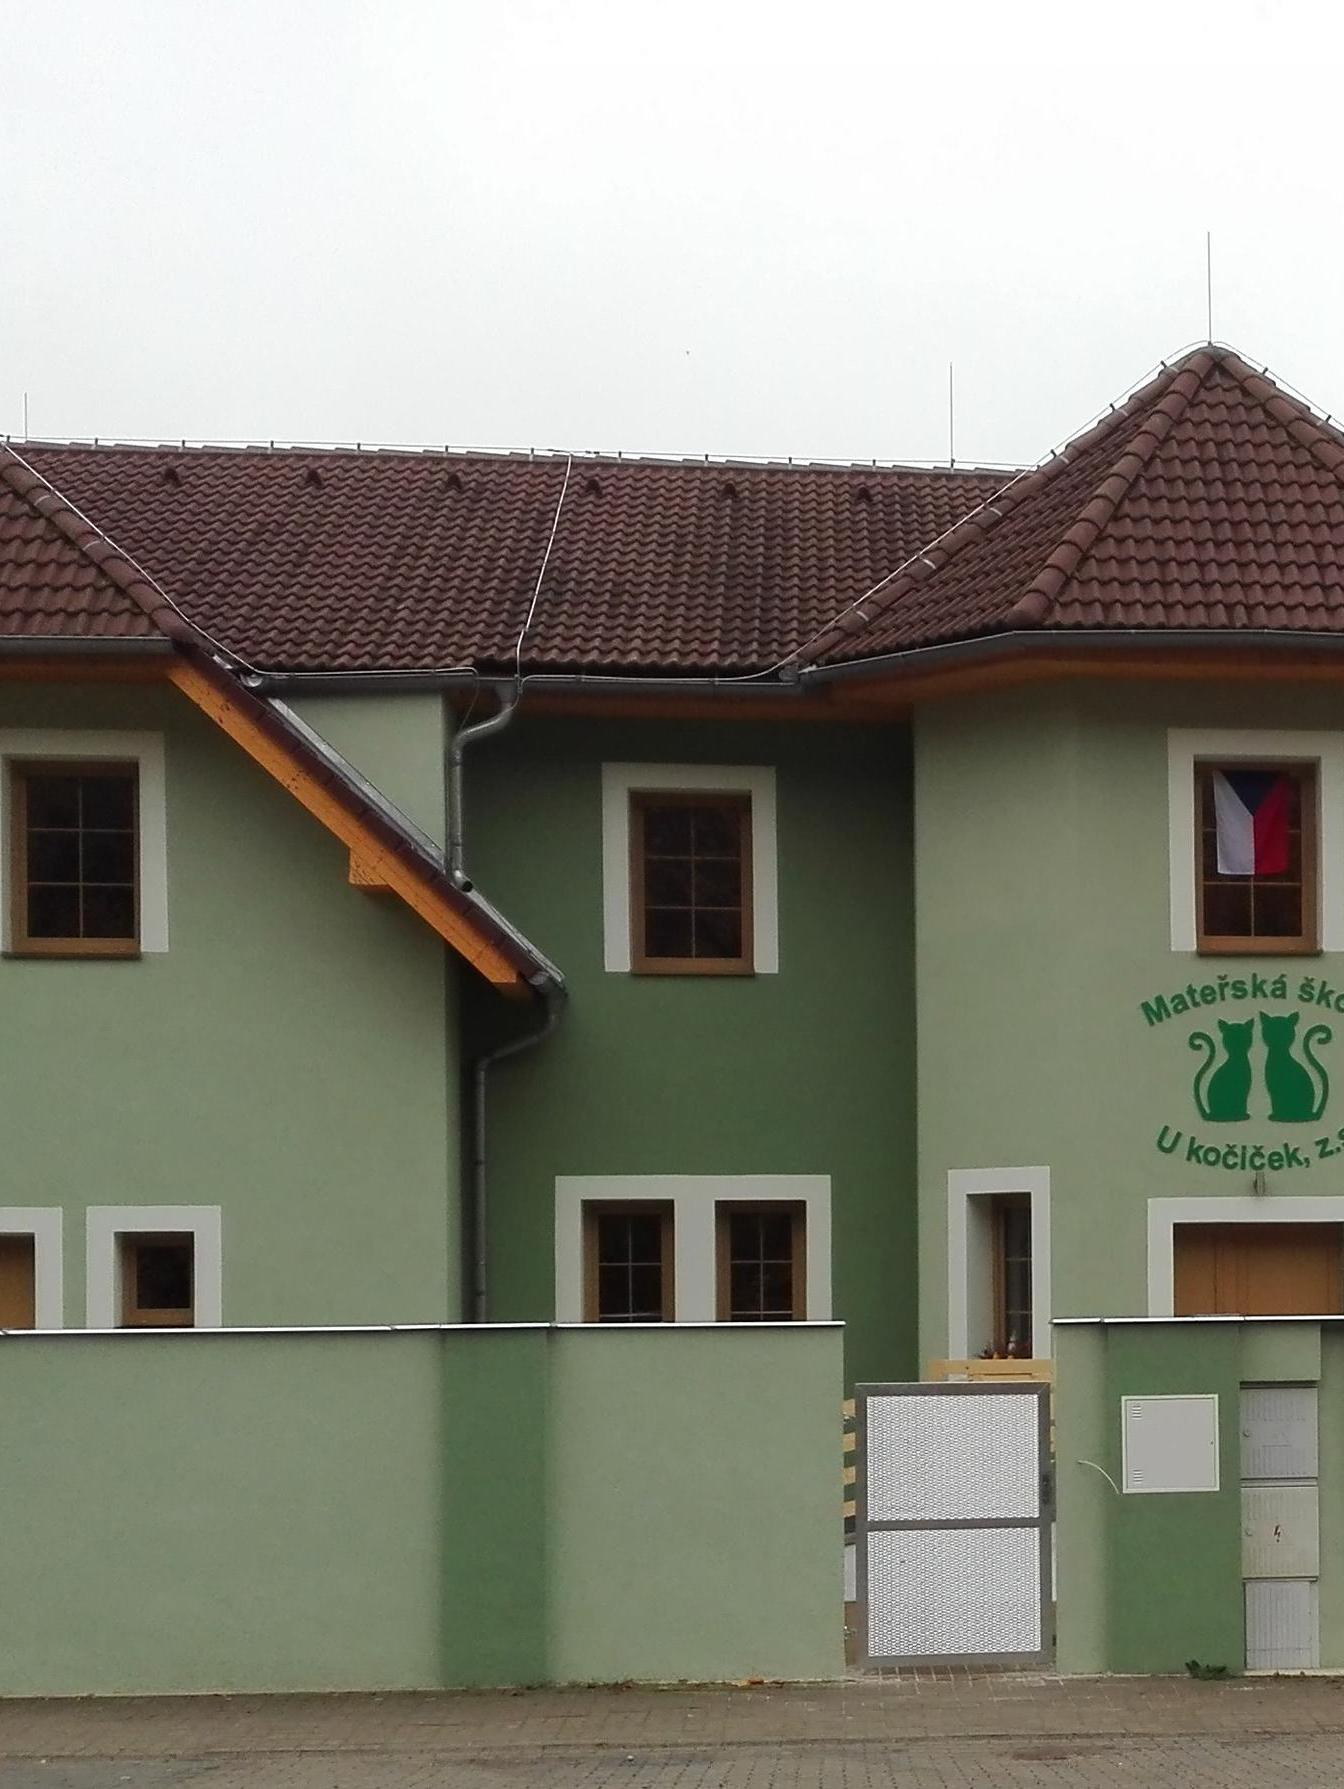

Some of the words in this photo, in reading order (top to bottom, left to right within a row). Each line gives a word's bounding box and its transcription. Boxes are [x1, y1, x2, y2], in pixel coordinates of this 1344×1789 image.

[1141, 973, 1287, 1026] Mateřská
[1157, 1125, 1182, 1154] U
[1186, 1136, 1310, 1171] kočiček,
